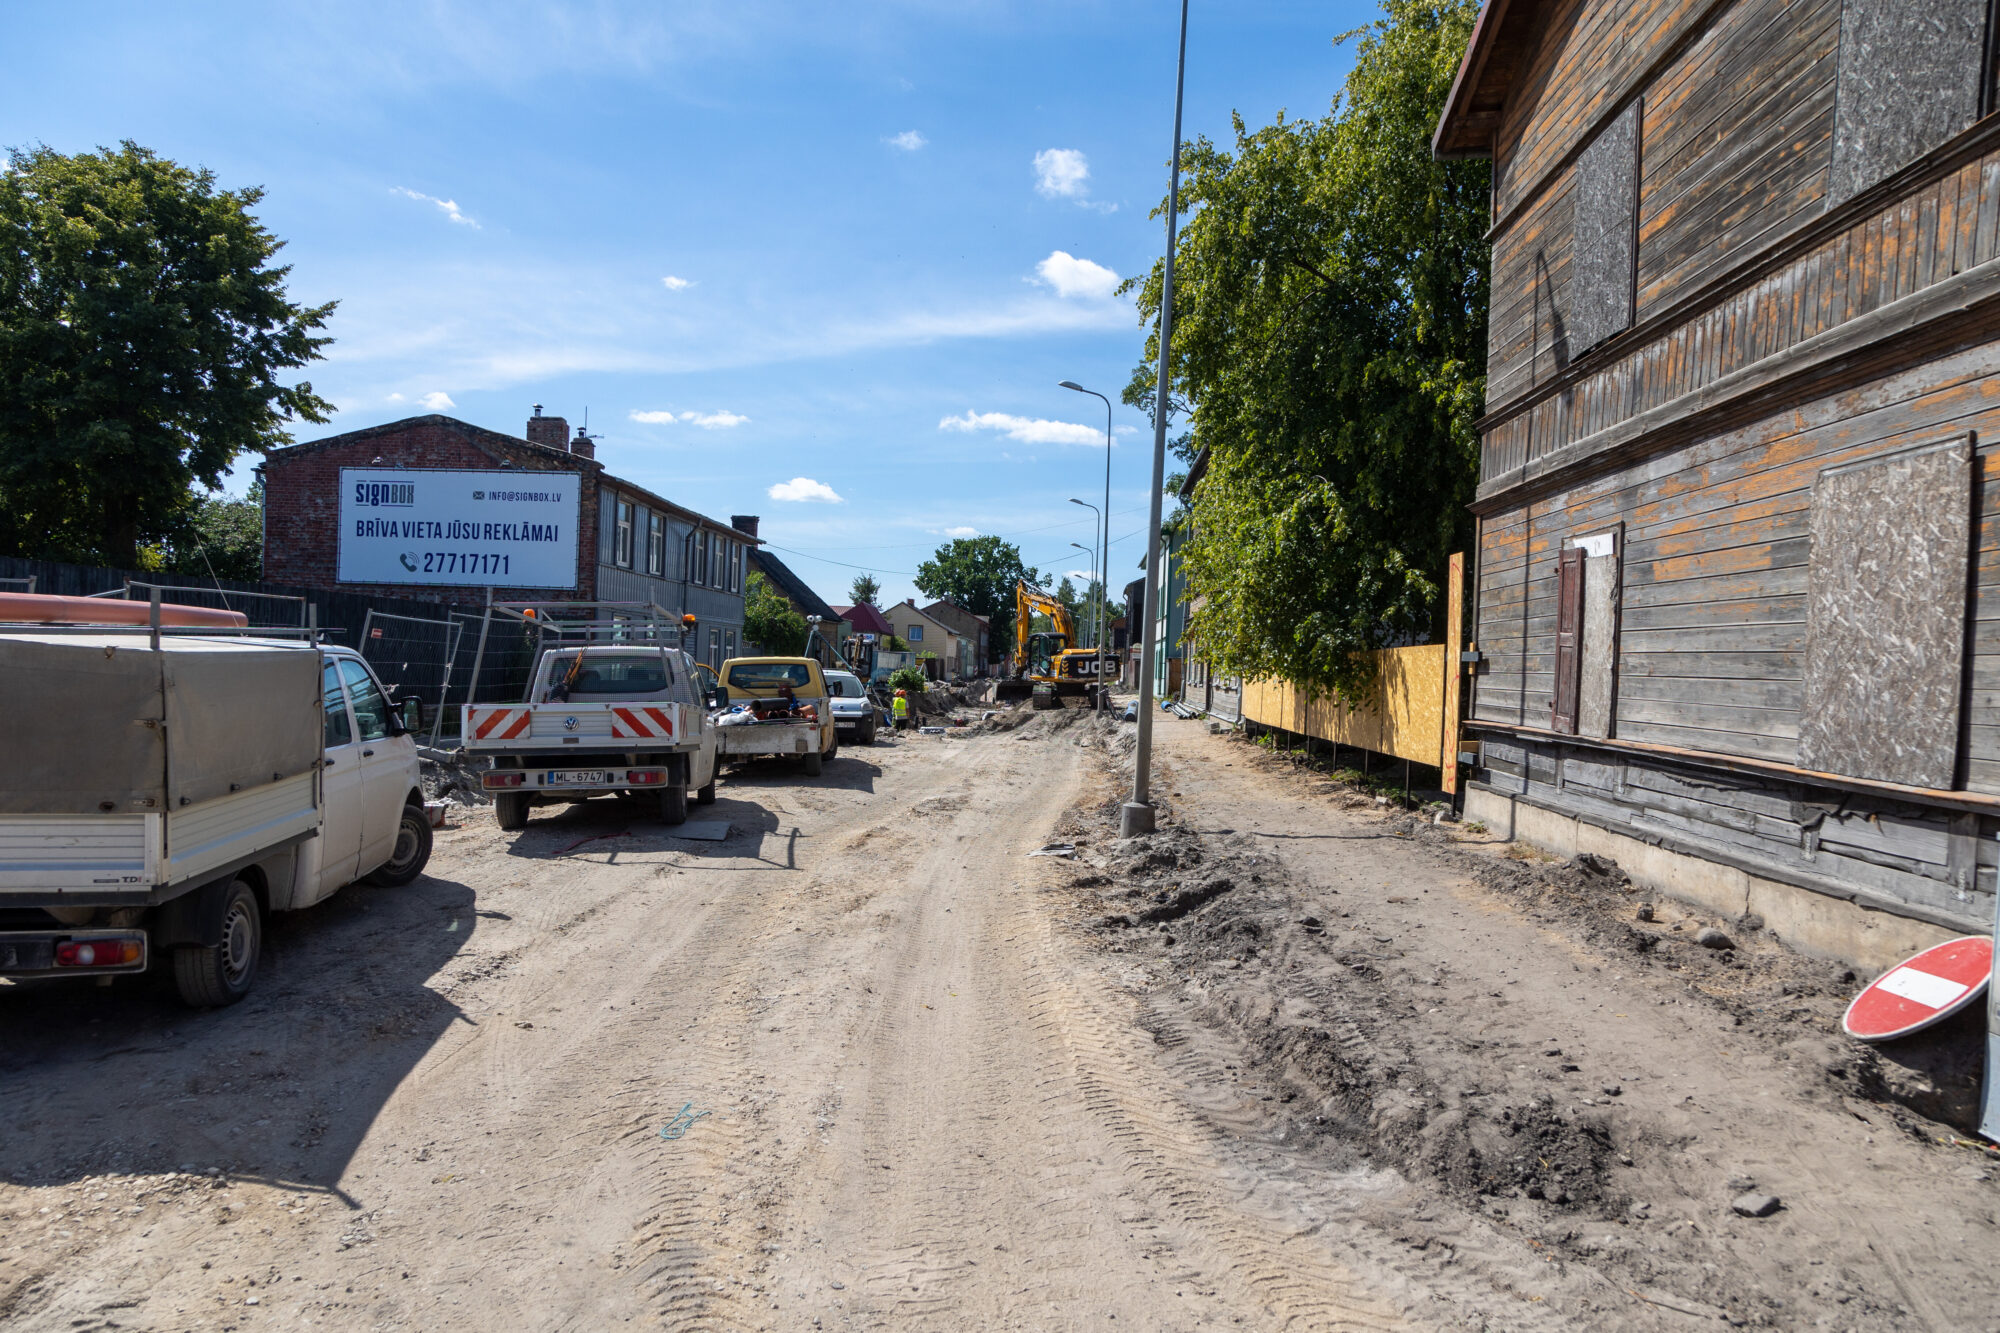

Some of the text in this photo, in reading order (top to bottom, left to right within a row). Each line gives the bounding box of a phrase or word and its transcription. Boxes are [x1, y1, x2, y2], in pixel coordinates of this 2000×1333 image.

[488, 491, 562, 503] INFO@SIGNBOX.LV
[356, 518, 559, 542] BRĪVA VIETA JŪSU REKLĀMAI
[423, 552, 510, 575] 27717171
